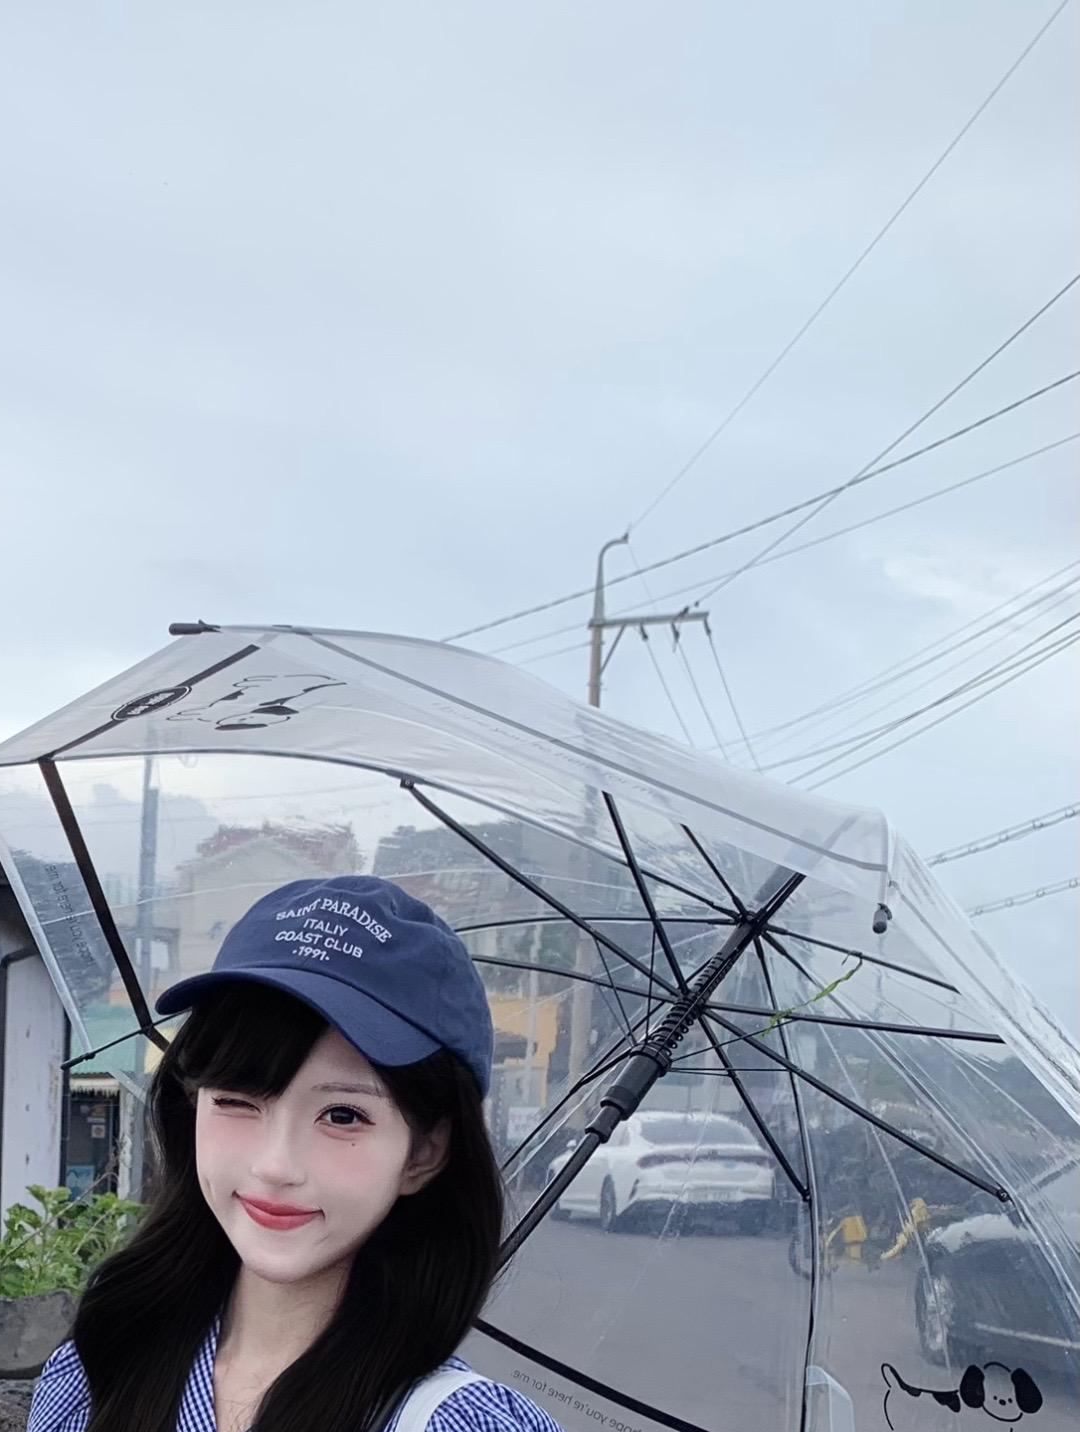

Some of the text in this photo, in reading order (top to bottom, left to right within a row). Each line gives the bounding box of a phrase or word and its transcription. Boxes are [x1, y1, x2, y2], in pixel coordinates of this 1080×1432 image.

[275, 897, 393, 943] SAINT PARADISE
[303, 917, 349, 937] ITALIY
[274, 930, 364, 958] COAST CLUB
